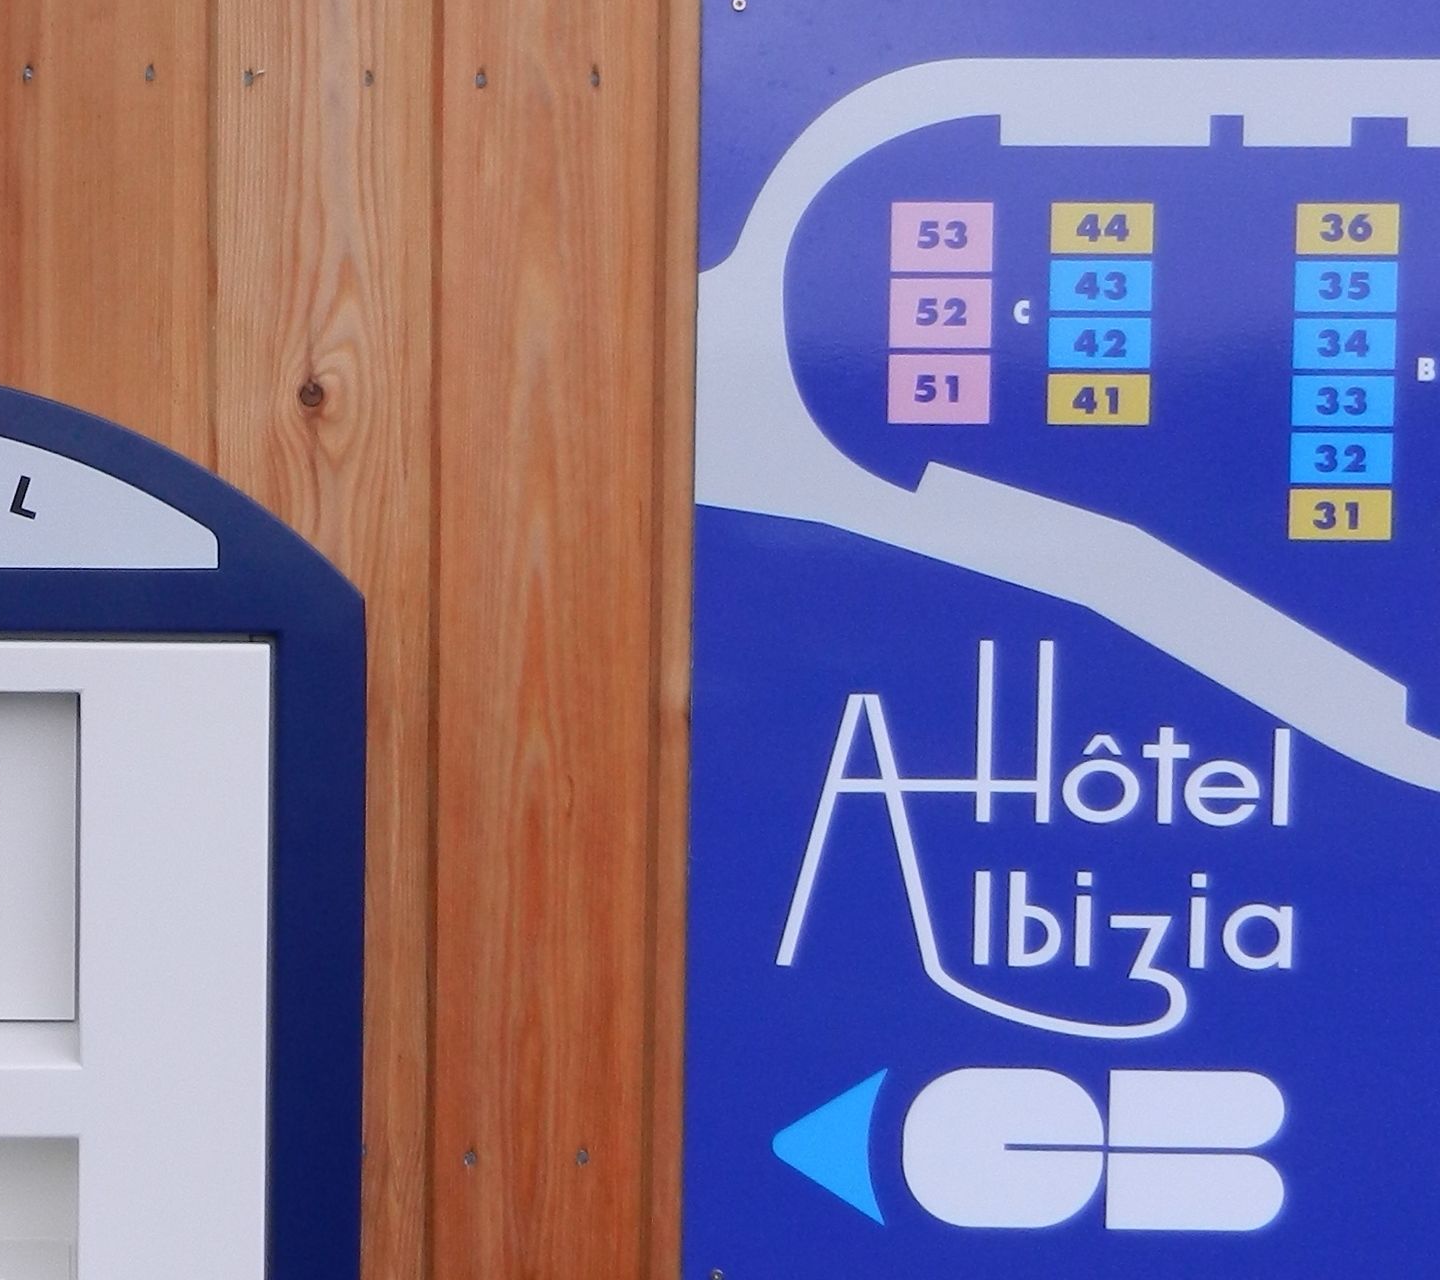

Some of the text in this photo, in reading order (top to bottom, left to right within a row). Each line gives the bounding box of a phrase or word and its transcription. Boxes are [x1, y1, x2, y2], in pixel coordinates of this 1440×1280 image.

[917, 220, 968, 250] 53
[1076, 213, 1130, 243] 44
[1319, 213, 1373, 243] 36
[1074, 271, 1128, 301] 43
[1318, 271, 1371, 301] 35
[915, 297, 967, 327] 52
[1013, 299, 1030, 325] C
[1073, 328, 1128, 358] 42
[1317, 328, 1370, 358] 34
[1417, 357, 1436, 382] B
[914, 374, 960, 403] 51
[1072, 386, 1119, 415] 41
[1315, 386, 1368, 416] 33
[1314, 444, 1367, 473] 32
[1312, 501, 1359, 530] 31
[975, 639, 1291, 827] Hôtel
[776, 693, 1294, 1039] Albizia
